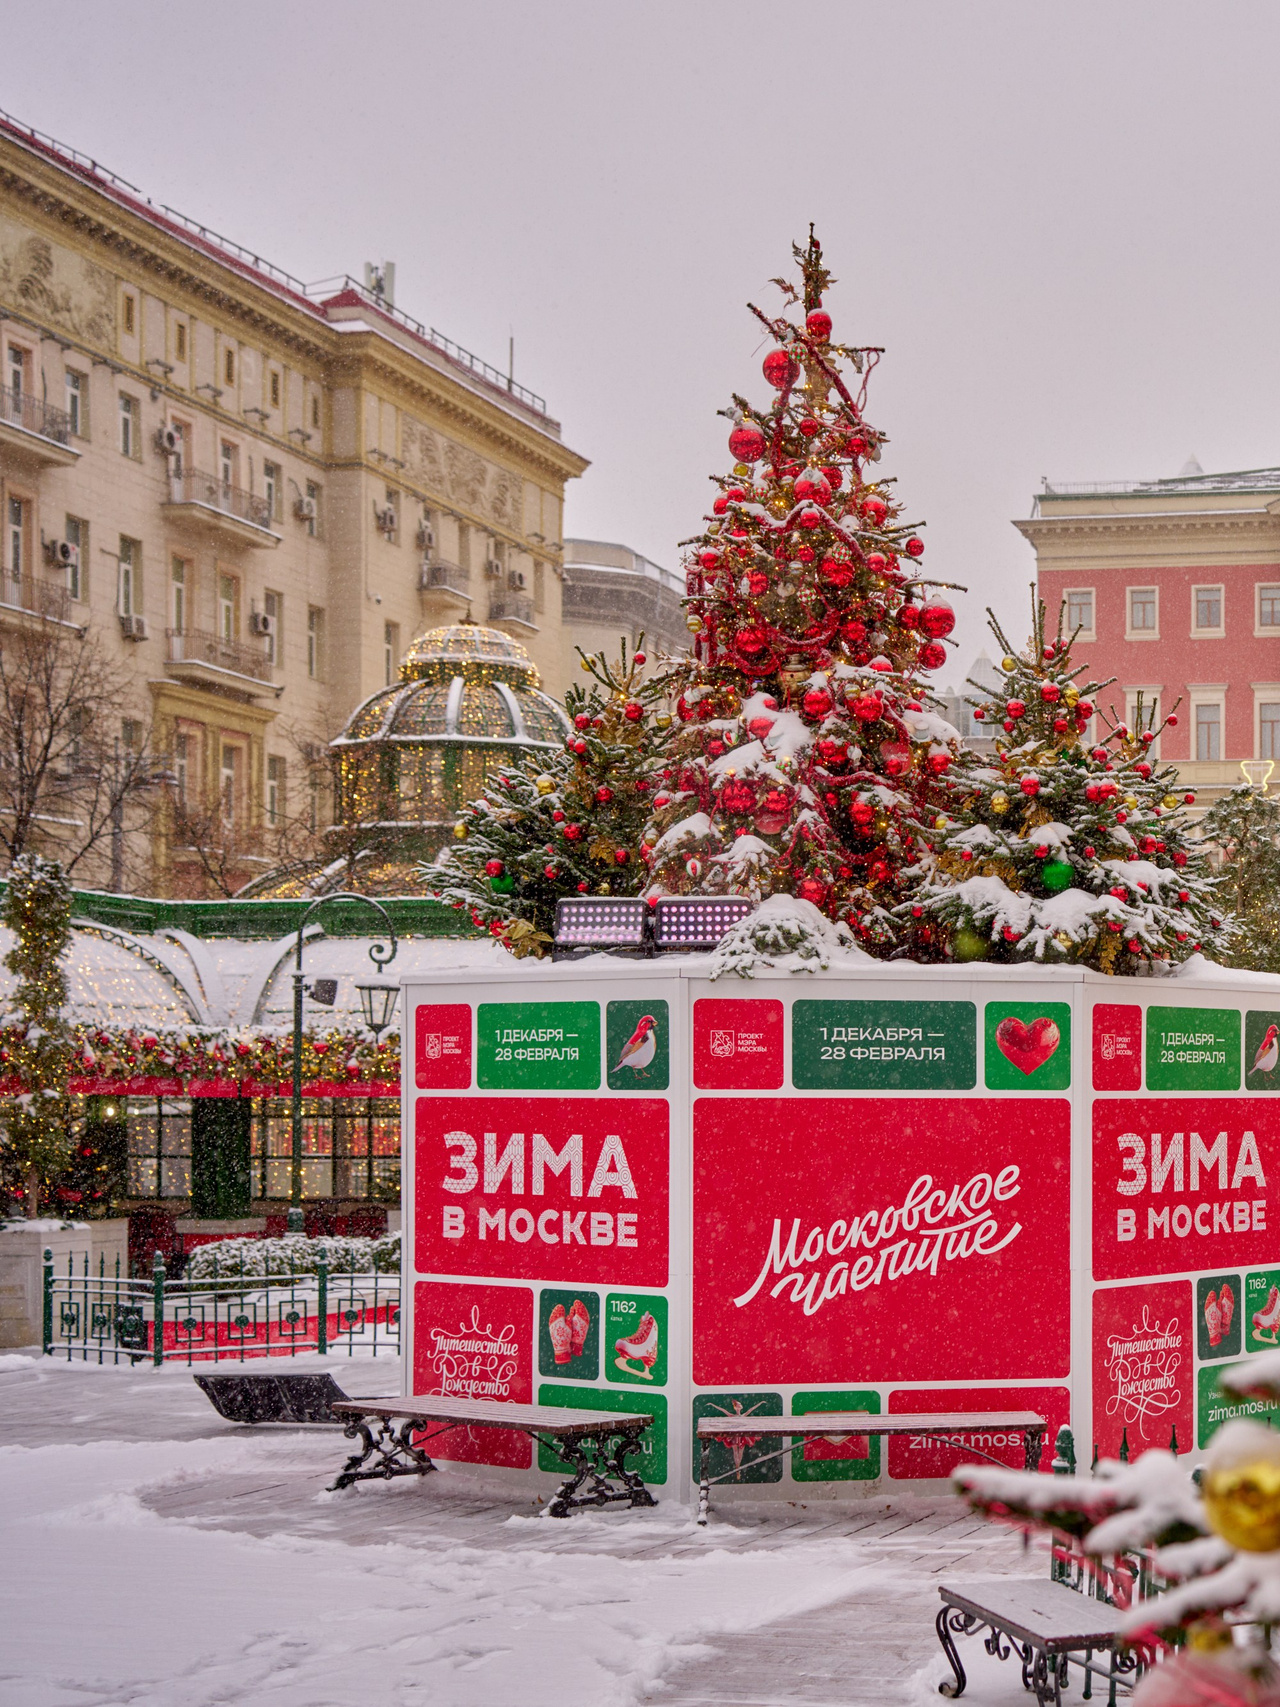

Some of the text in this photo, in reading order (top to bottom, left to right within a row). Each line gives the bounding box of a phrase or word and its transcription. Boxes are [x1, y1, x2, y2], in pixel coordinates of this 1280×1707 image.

[495, 1030, 501, 1042] 1
[502, 1029, 563, 1043] ДЕКАБРЯ
[820, 1028, 828, 1040] 1
[831, 1027, 923, 1043] ДЕКАБРЯ
[1160, 1033, 1166, 1044] 1
[1167, 1033, 1214, 1046] ДЕКАБРЯ
[495, 1048, 579, 1061] 28 ФЕВРАЛЯ
[820, 1046, 945, 1061] 28 ФЕВРАЛЯ
[1160, 1051, 1226, 1064] 28 ФЕВРАЛЯ
[442, 1131, 639, 1199] ЗИМА
[1116, 1131, 1267, 1196] ЗИМА
[442, 1205, 639, 1248] В МОСКВЕ
[1117, 1200, 1267, 1242] В МОСКВЕ
[733, 1165, 1021, 1308] Московское
[1248, 1278, 1267, 1290] 1162
[611, 1300, 637, 1314] 1162
[427, 1326, 519, 1358] Путешествие
[1104, 1334, 1183, 1367] Путешествие
[1110, 1360, 1176, 1401] Рождество
[1208, 1399, 1278, 1422] zima.mos.ru
[909, 1432, 1049, 1449] zima.mos.u
